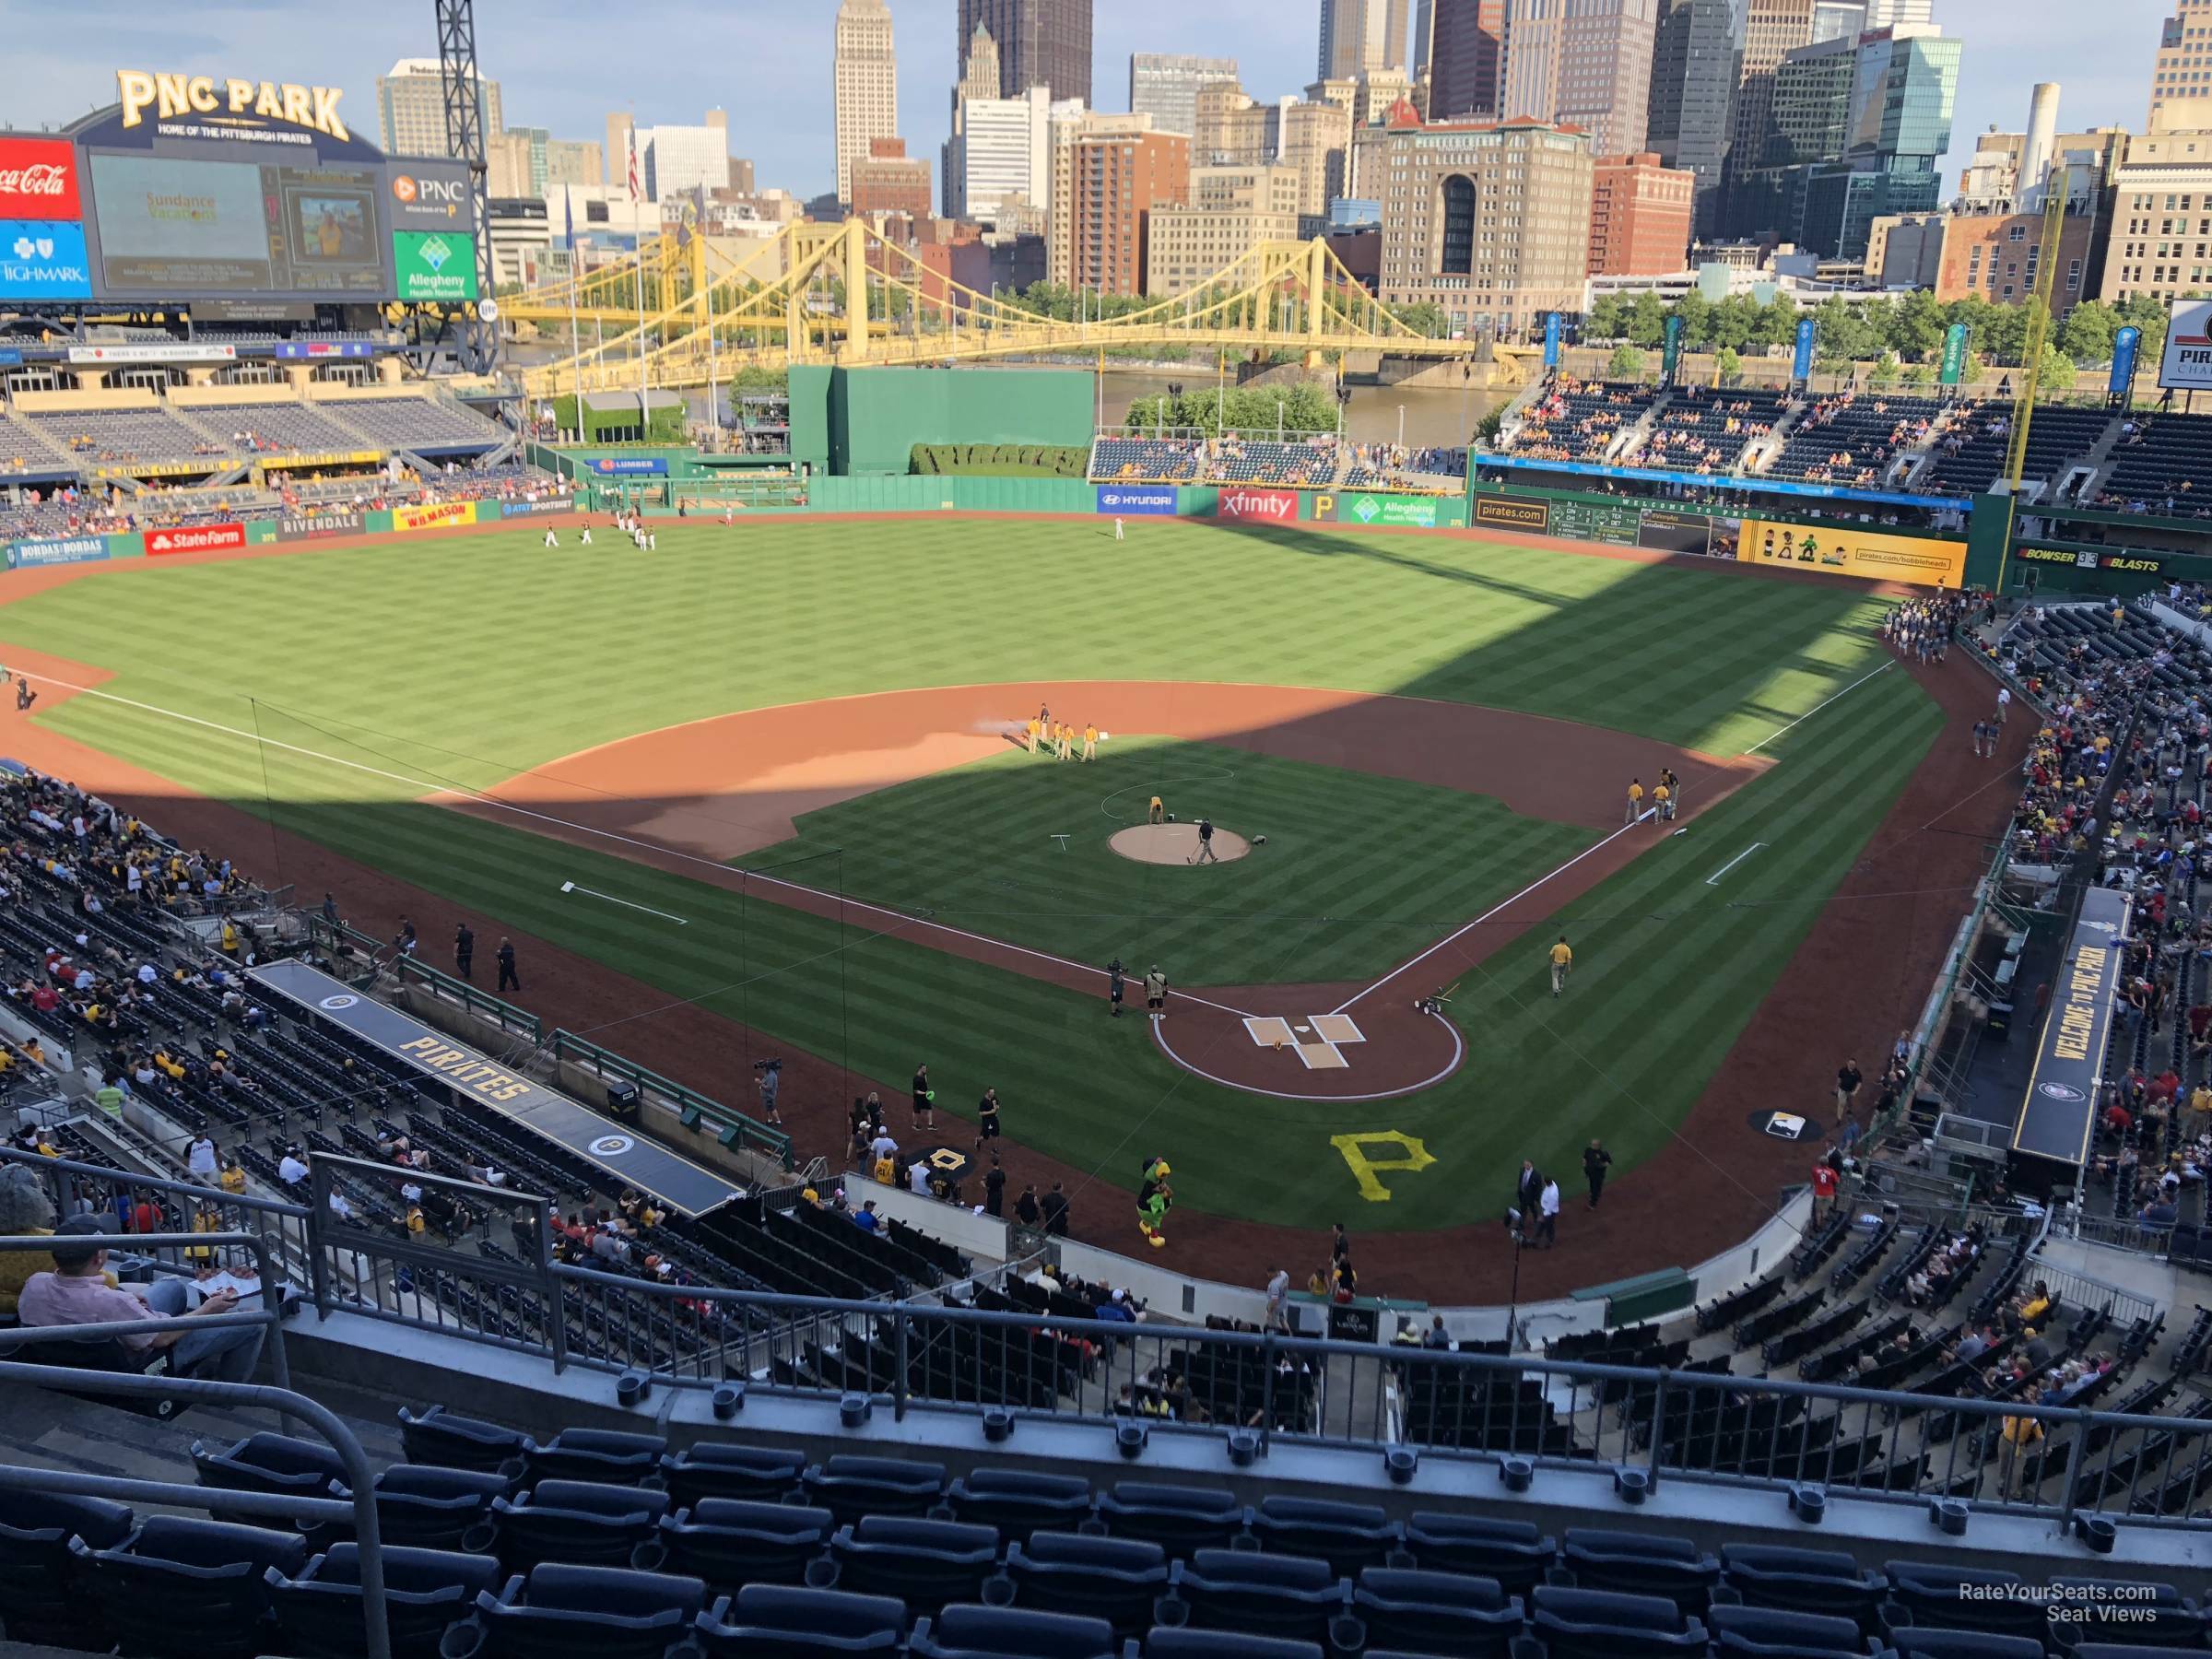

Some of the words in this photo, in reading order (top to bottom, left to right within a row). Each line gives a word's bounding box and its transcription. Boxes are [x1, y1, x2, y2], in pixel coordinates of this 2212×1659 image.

[117, 69, 219, 129] PNC
[226, 78, 350, 142] PARK
[158, 123, 184, 135] HOME
[186, 125, 199, 136] OF
[200, 125, 220, 137] THE
[220, 127, 276, 142] PITTSBURGH
[276, 131, 312, 145] PIRATES
[147, 192, 216, 207] Sundance
[418, 179, 465, 202] PNC
[408, 273, 465, 289] Allegheny
[409, 288, 434, 297] Health
[2179, 349, 2212, 364] PIR
[616, 461, 653, 469] LUMBER
[531, 500, 572, 512] SPORTSNET
[1123, 496, 1172, 505] HYUNDAI
[1223, 491, 1291, 518] xfinity
[1315, 496, 1333, 520] P
[1383, 501, 1436, 514] Allegheny
[1622, 498, 1685, 512] WELCOME
[1696, 506, 1711, 514] TO
[1723, 509, 1748, 518] PNC
[1482, 504, 1541, 520] pirates.com
[283, 514, 359, 534] RIVENDALE
[20, 544, 60, 559] BORDAS
[64, 539, 102, 554] BORDAS
[1859, 551, 1947, 568] pirates.com/bobbleheads
[2026, 548, 2077, 563] BOWSER
[2110, 558, 2159, 571] BLASTS
[2075, 946, 2107, 971] PARK
[2070, 970, 2101, 994] PNC
[2071, 992, 2093, 1004] TO
[2054, 1004, 2095, 1060] WELCOME
[398, 1036, 531, 1101] PIRATES
[1329, 1129, 1439, 1202] P
